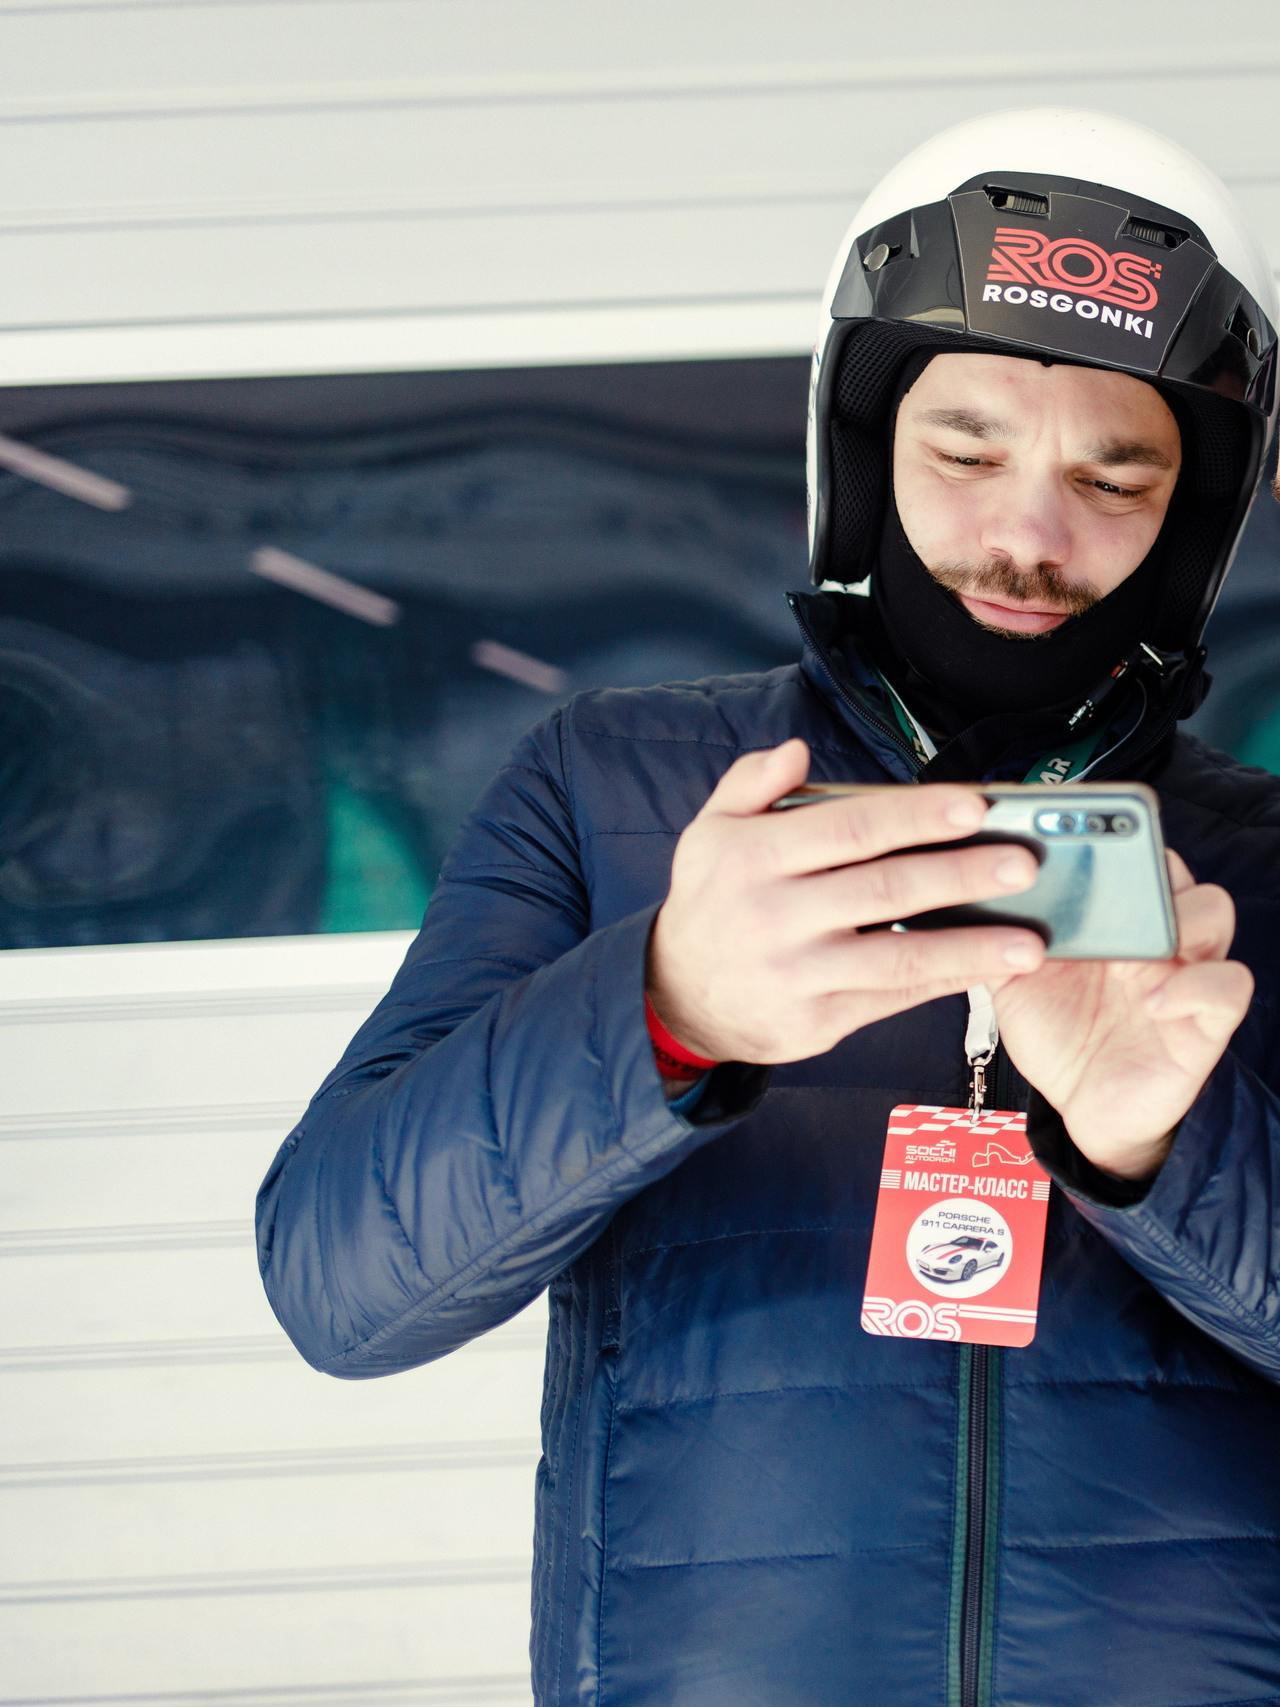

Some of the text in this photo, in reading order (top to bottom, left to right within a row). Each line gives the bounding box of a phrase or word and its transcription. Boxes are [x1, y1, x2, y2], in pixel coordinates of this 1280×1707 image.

[986, 227, 1162, 312] ROS
[982, 284, 1154, 339] ROSGONKI
[904, 1155, 956, 1163] AUTODROM
[905, 1145, 957, 1158] SOCHI
[903, 1170, 1029, 1199] МАСТЕР-КЛАСС
[921, 1219, 1005, 1236] 911 CARRERA S
[938, 1211, 991, 1224] PORSCHE
[861, 1296, 962, 1341] ROS
